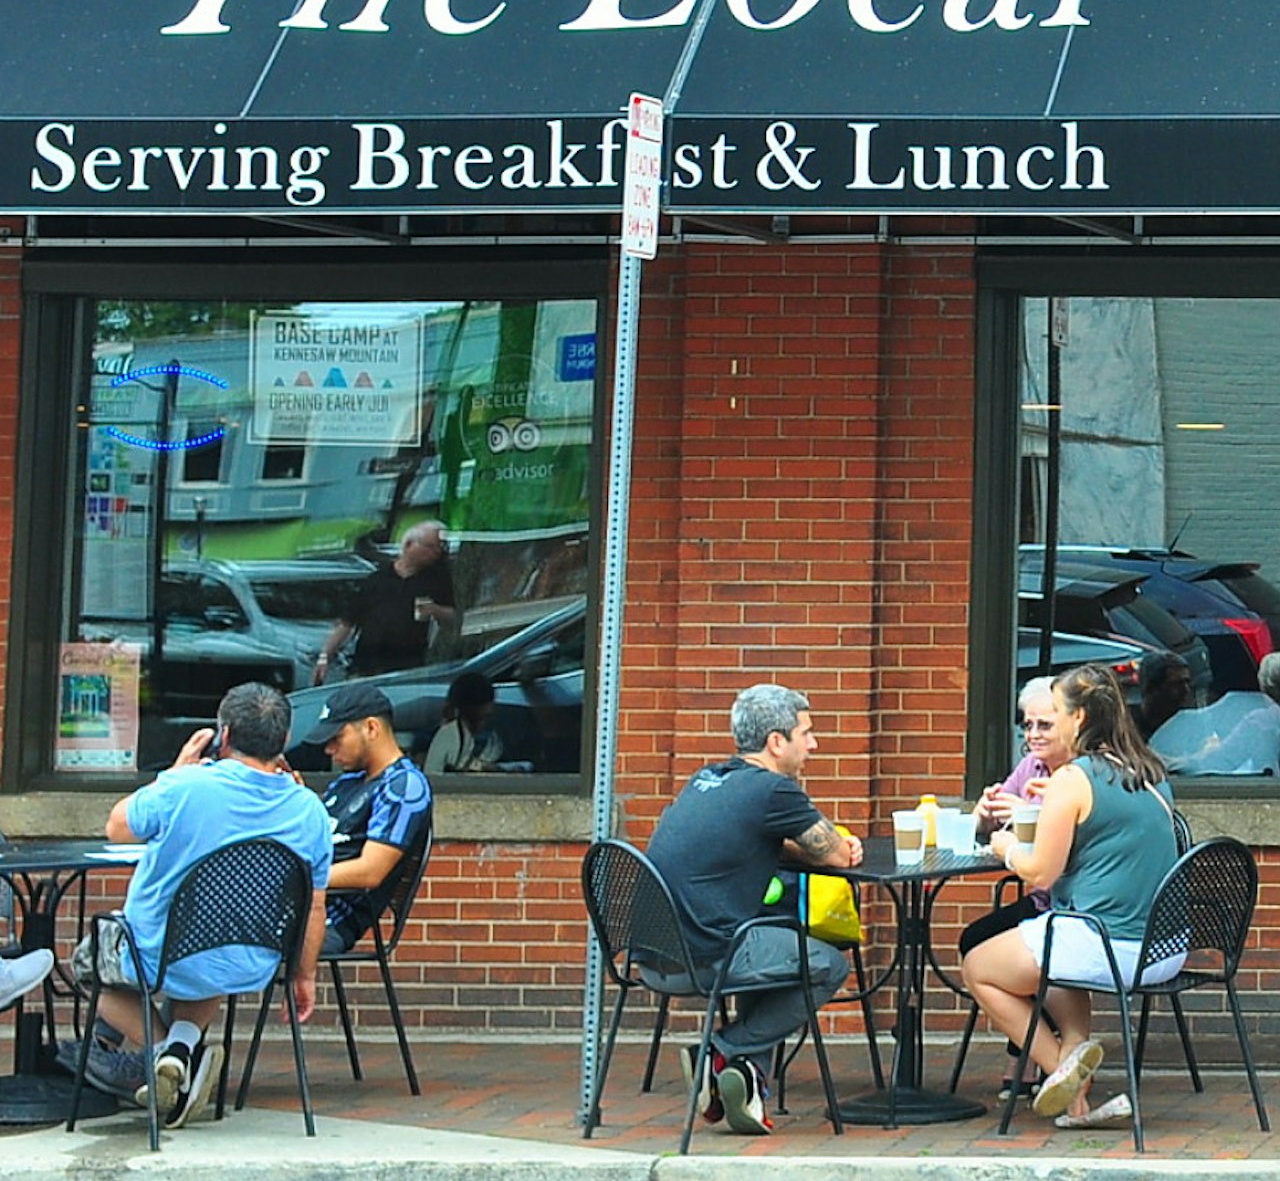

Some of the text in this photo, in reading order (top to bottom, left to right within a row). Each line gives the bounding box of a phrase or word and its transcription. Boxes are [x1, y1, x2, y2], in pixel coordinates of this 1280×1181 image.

[31, 122, 330, 206] Serving
[350, 116, 738, 190] Breakfst
[756, 120, 822, 191] &
[846, 122, 1110, 190] Lunch
[274, 321, 399, 346] BASE CAMP AT
[273, 346, 399, 363] KENNESAW MOUNTAIN
[269, 392, 323, 411] OPENING
[325, 393, 365, 412] EARLY
